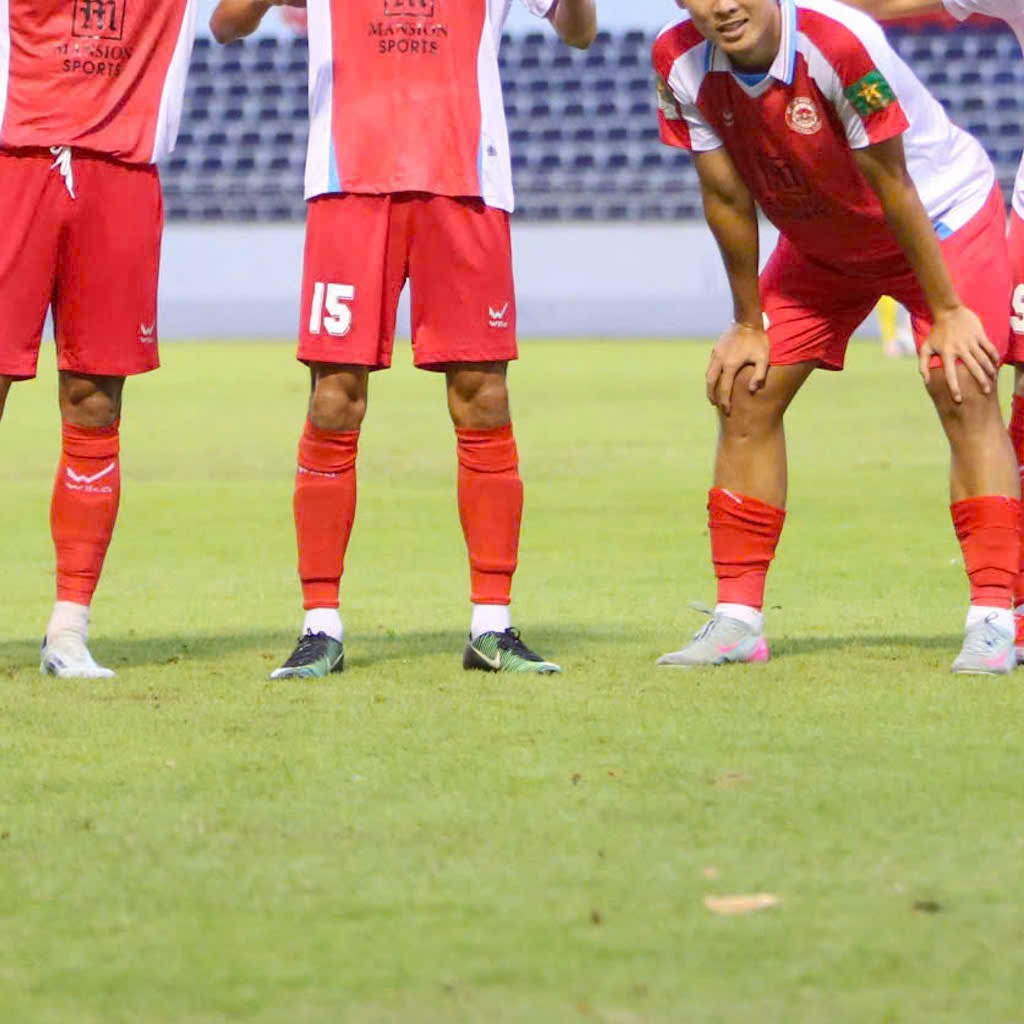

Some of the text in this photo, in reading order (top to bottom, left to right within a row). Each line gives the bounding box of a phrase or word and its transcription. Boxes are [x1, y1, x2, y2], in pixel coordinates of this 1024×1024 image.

[368, 22, 448, 37] MANSION
[57, 43, 134, 61] MSION
[379, 39, 438, 55] SPORTS
[63, 59, 122, 77] SPORTS
[309, 282, 354, 336] 15
